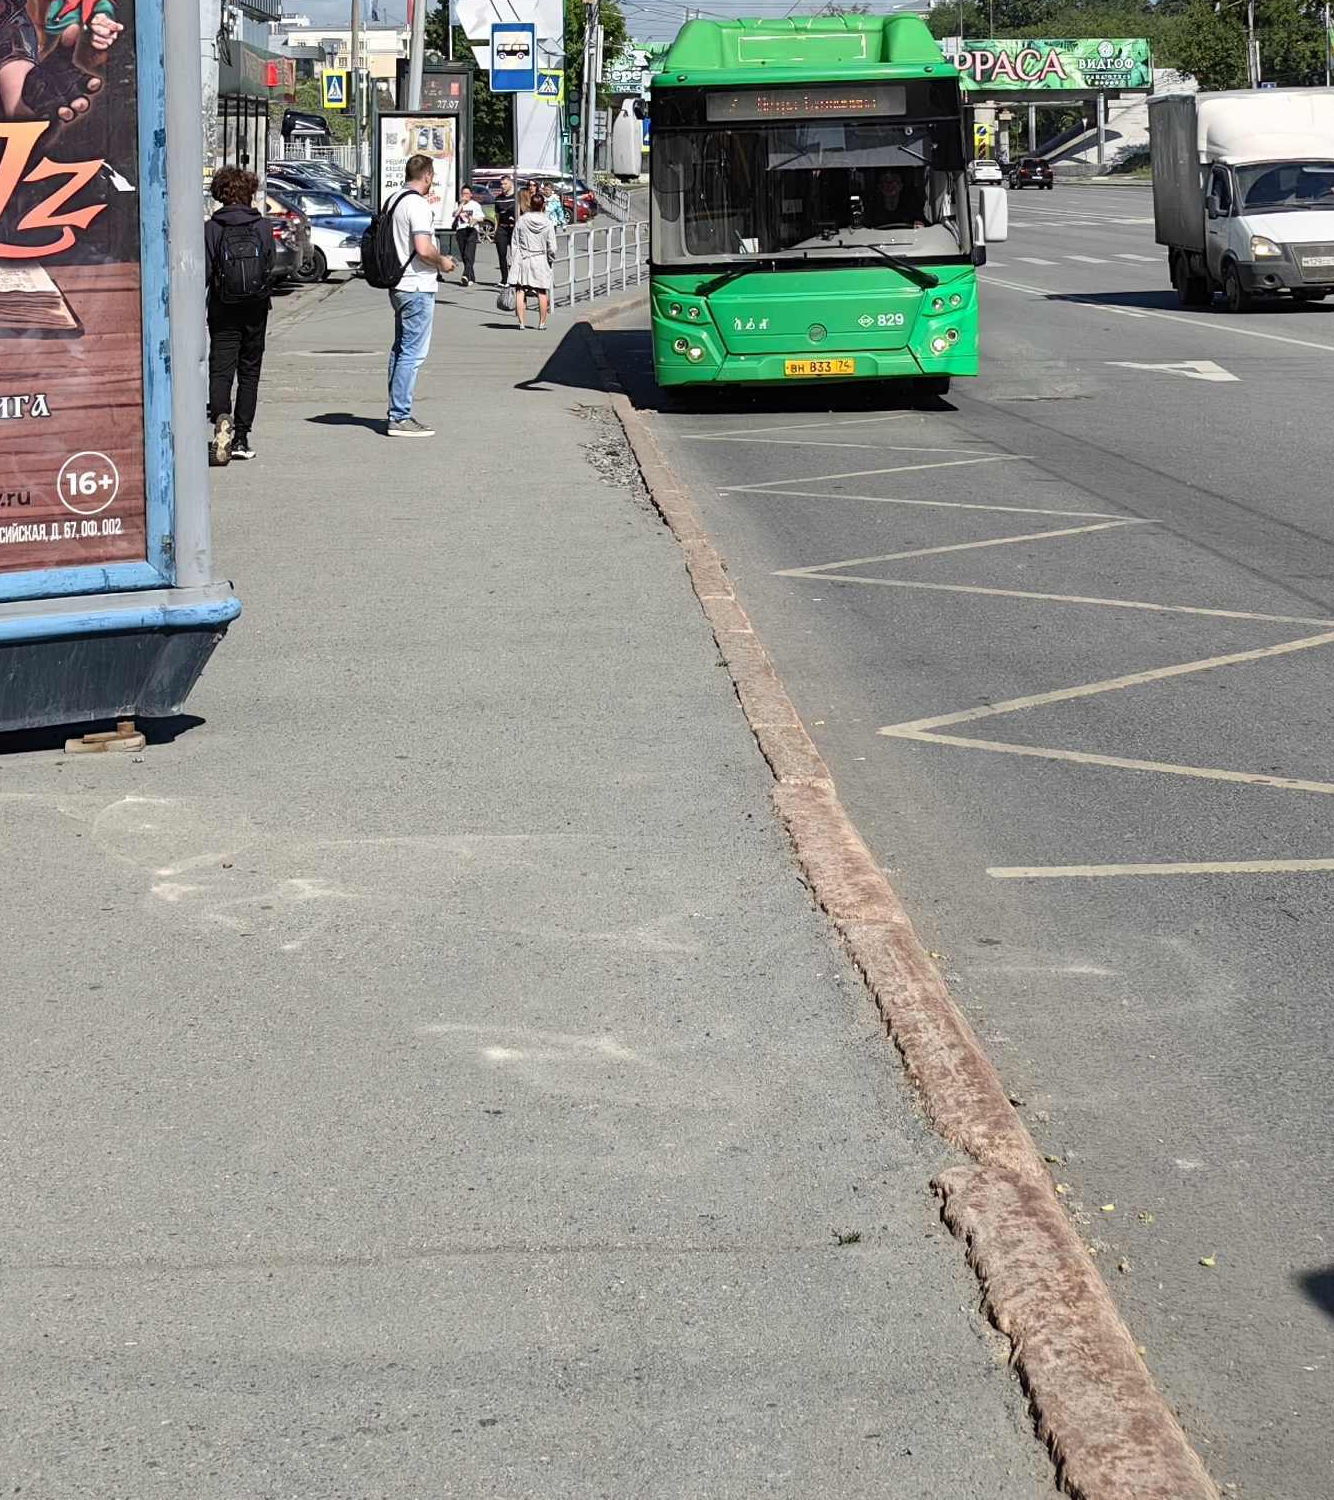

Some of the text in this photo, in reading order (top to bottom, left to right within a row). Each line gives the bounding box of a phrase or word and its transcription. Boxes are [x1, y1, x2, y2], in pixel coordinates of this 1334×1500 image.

[953, 48, 1067, 82] РРАСА
[1077, 57, 1134, 70] ВИДГОФ
[876, 312, 905, 327] 829
[66, 470, 114, 496] 16+
[49, 522, 62, 541] Д.
[81, 520, 101, 537] ОФ.
